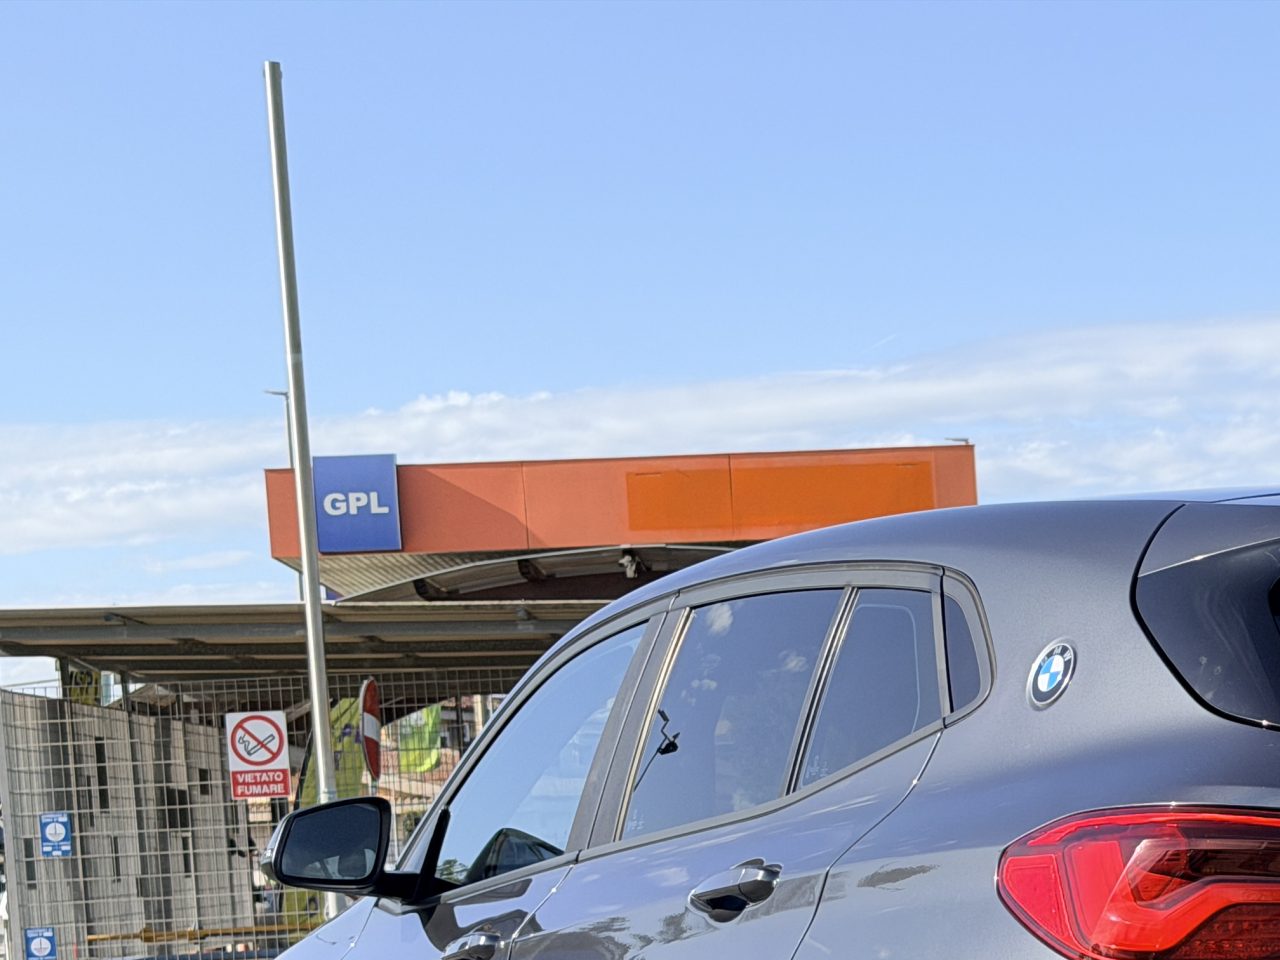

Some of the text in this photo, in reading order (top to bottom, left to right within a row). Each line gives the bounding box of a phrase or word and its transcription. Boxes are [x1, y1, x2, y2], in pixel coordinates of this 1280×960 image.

[323, 491, 390, 516] GPL
[237, 771, 284, 783] VIETATO
[237, 783, 285, 796] FUMARE
